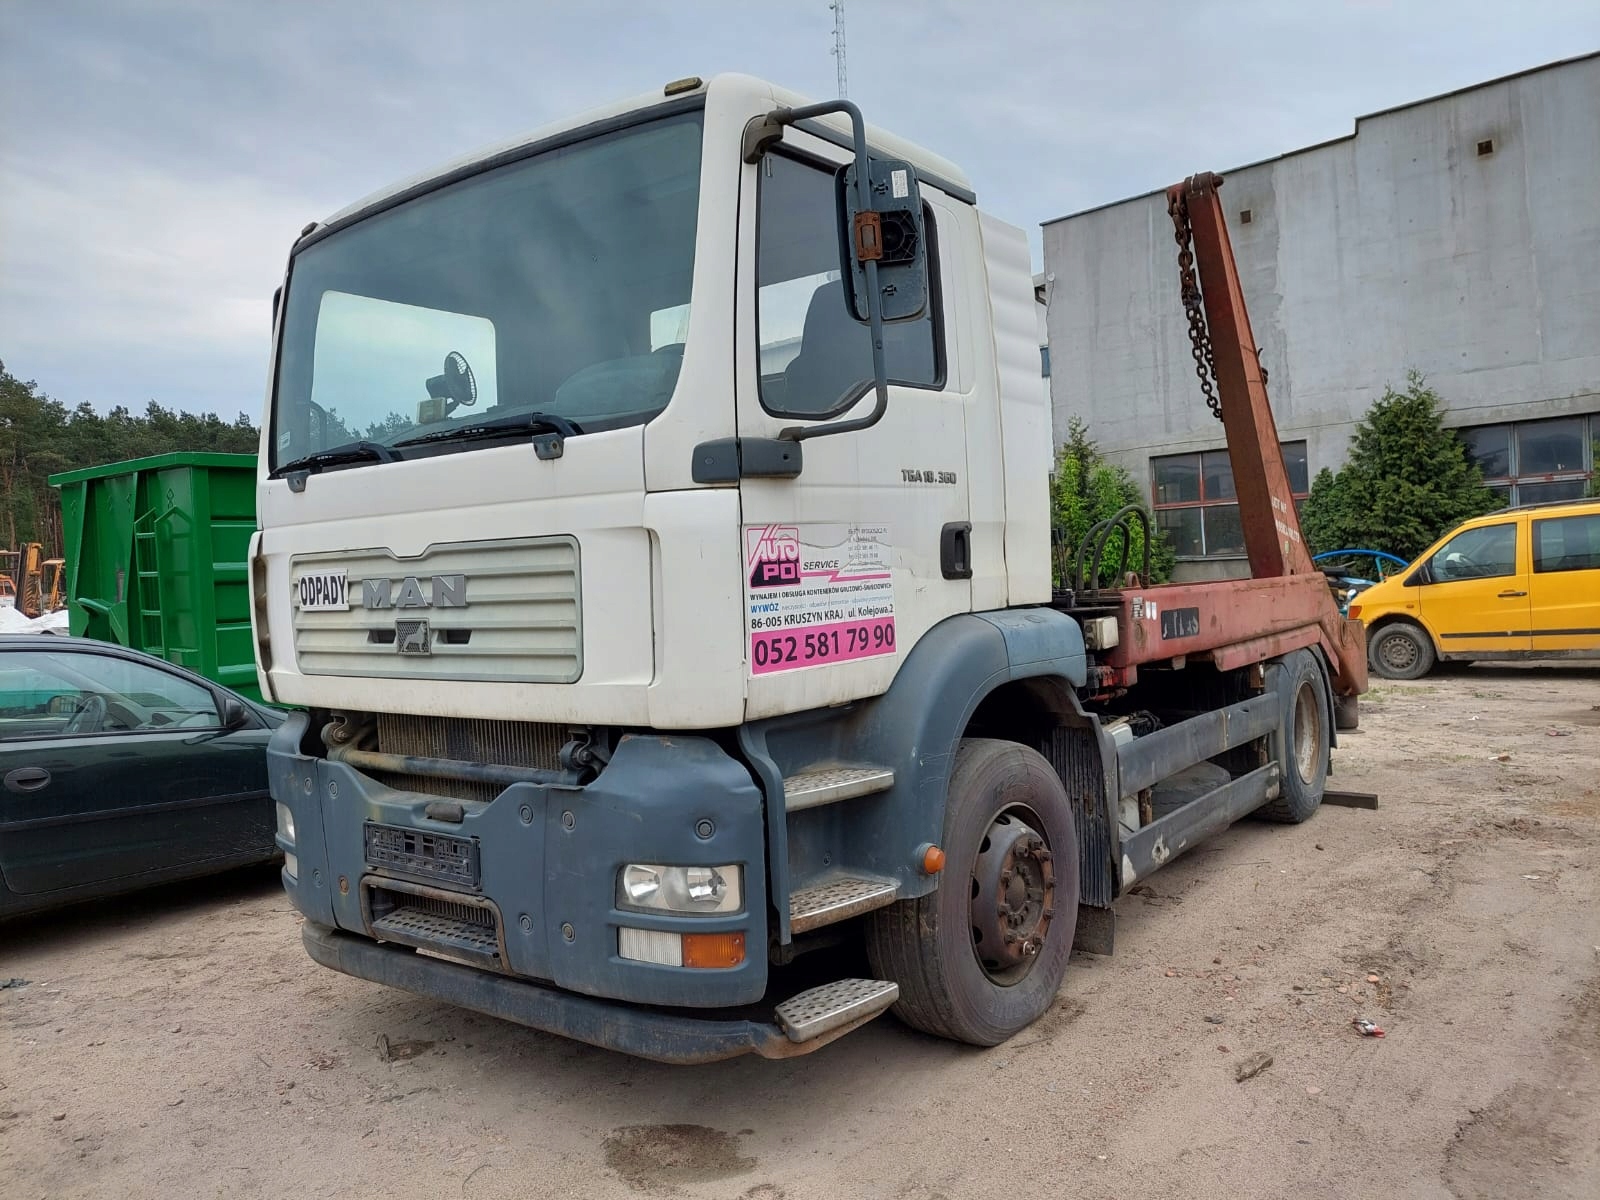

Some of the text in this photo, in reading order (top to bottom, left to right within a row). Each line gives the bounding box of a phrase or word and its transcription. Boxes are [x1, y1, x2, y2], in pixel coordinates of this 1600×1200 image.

[755, 537, 800, 563] AUTO
[803, 560, 839, 570] SERVICE
[300, 575, 346, 606] ODPADY
[362, 574, 467, 608] MAN
[750, 592, 778, 600] WYNAJEM
[781, 589, 806, 598] OBSŁUGA
[750, 602, 779, 613] WYWÓZ
[751, 616, 782, 629] 86-005
[784, 611, 823, 626] KRUSZYN
[824, 609, 844, 620] KRAJ
[858, 605, 888, 617] Kolejowa
[889, 603, 894, 613] 2
[754, 623, 895, 666] 052 581 79 90
